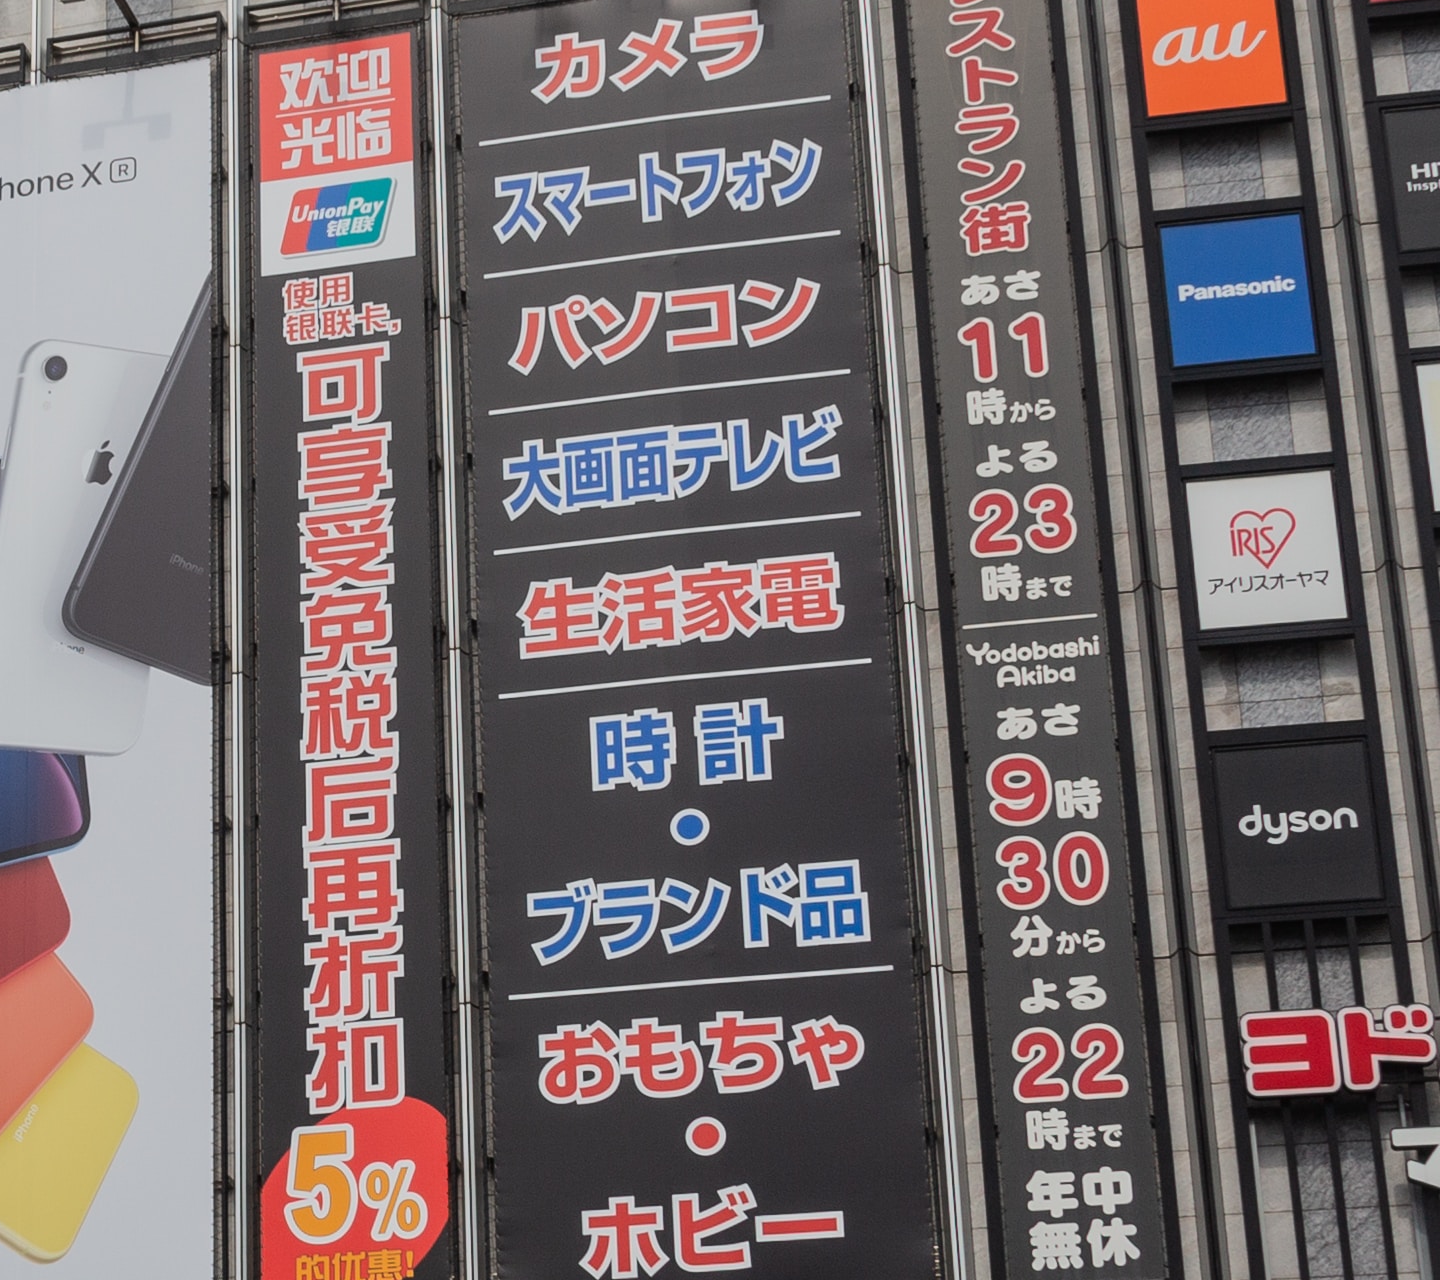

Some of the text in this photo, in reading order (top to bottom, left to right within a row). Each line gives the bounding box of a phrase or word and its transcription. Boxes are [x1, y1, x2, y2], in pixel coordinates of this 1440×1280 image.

[531, 9, 765, 105] カメラ
[291, 196, 386, 224] UnionPay
[491, 137, 823, 245] スマートフォン
[326, 216, 375, 239] 银联
[282, 271, 354, 314] 使用
[959, 268, 1044, 308] あさ
[1176, 274, 1298, 306] Panasonic
[507, 276, 822, 377] パソコン
[965, 386, 1058, 429] 時から
[501, 404, 844, 523] 大画面テレビ
[973, 439, 1060, 480] よる
[1207, 566, 1330, 597] アイリスオーヤマ
[518, 551, 846, 661] 生活家電
[965, 635, 1101, 668] Yodobashi
[995, 662, 1077, 690] Akiba
[995, 702, 1082, 742] あさ
[587, 697, 785, 793] 時計
[1237, 801, 1359, 847] dyson
[525, 858, 872, 967] ブランド品
[1018, 974, 1109, 1016] よる
[537, 1010, 866, 1106] おもちゃ
